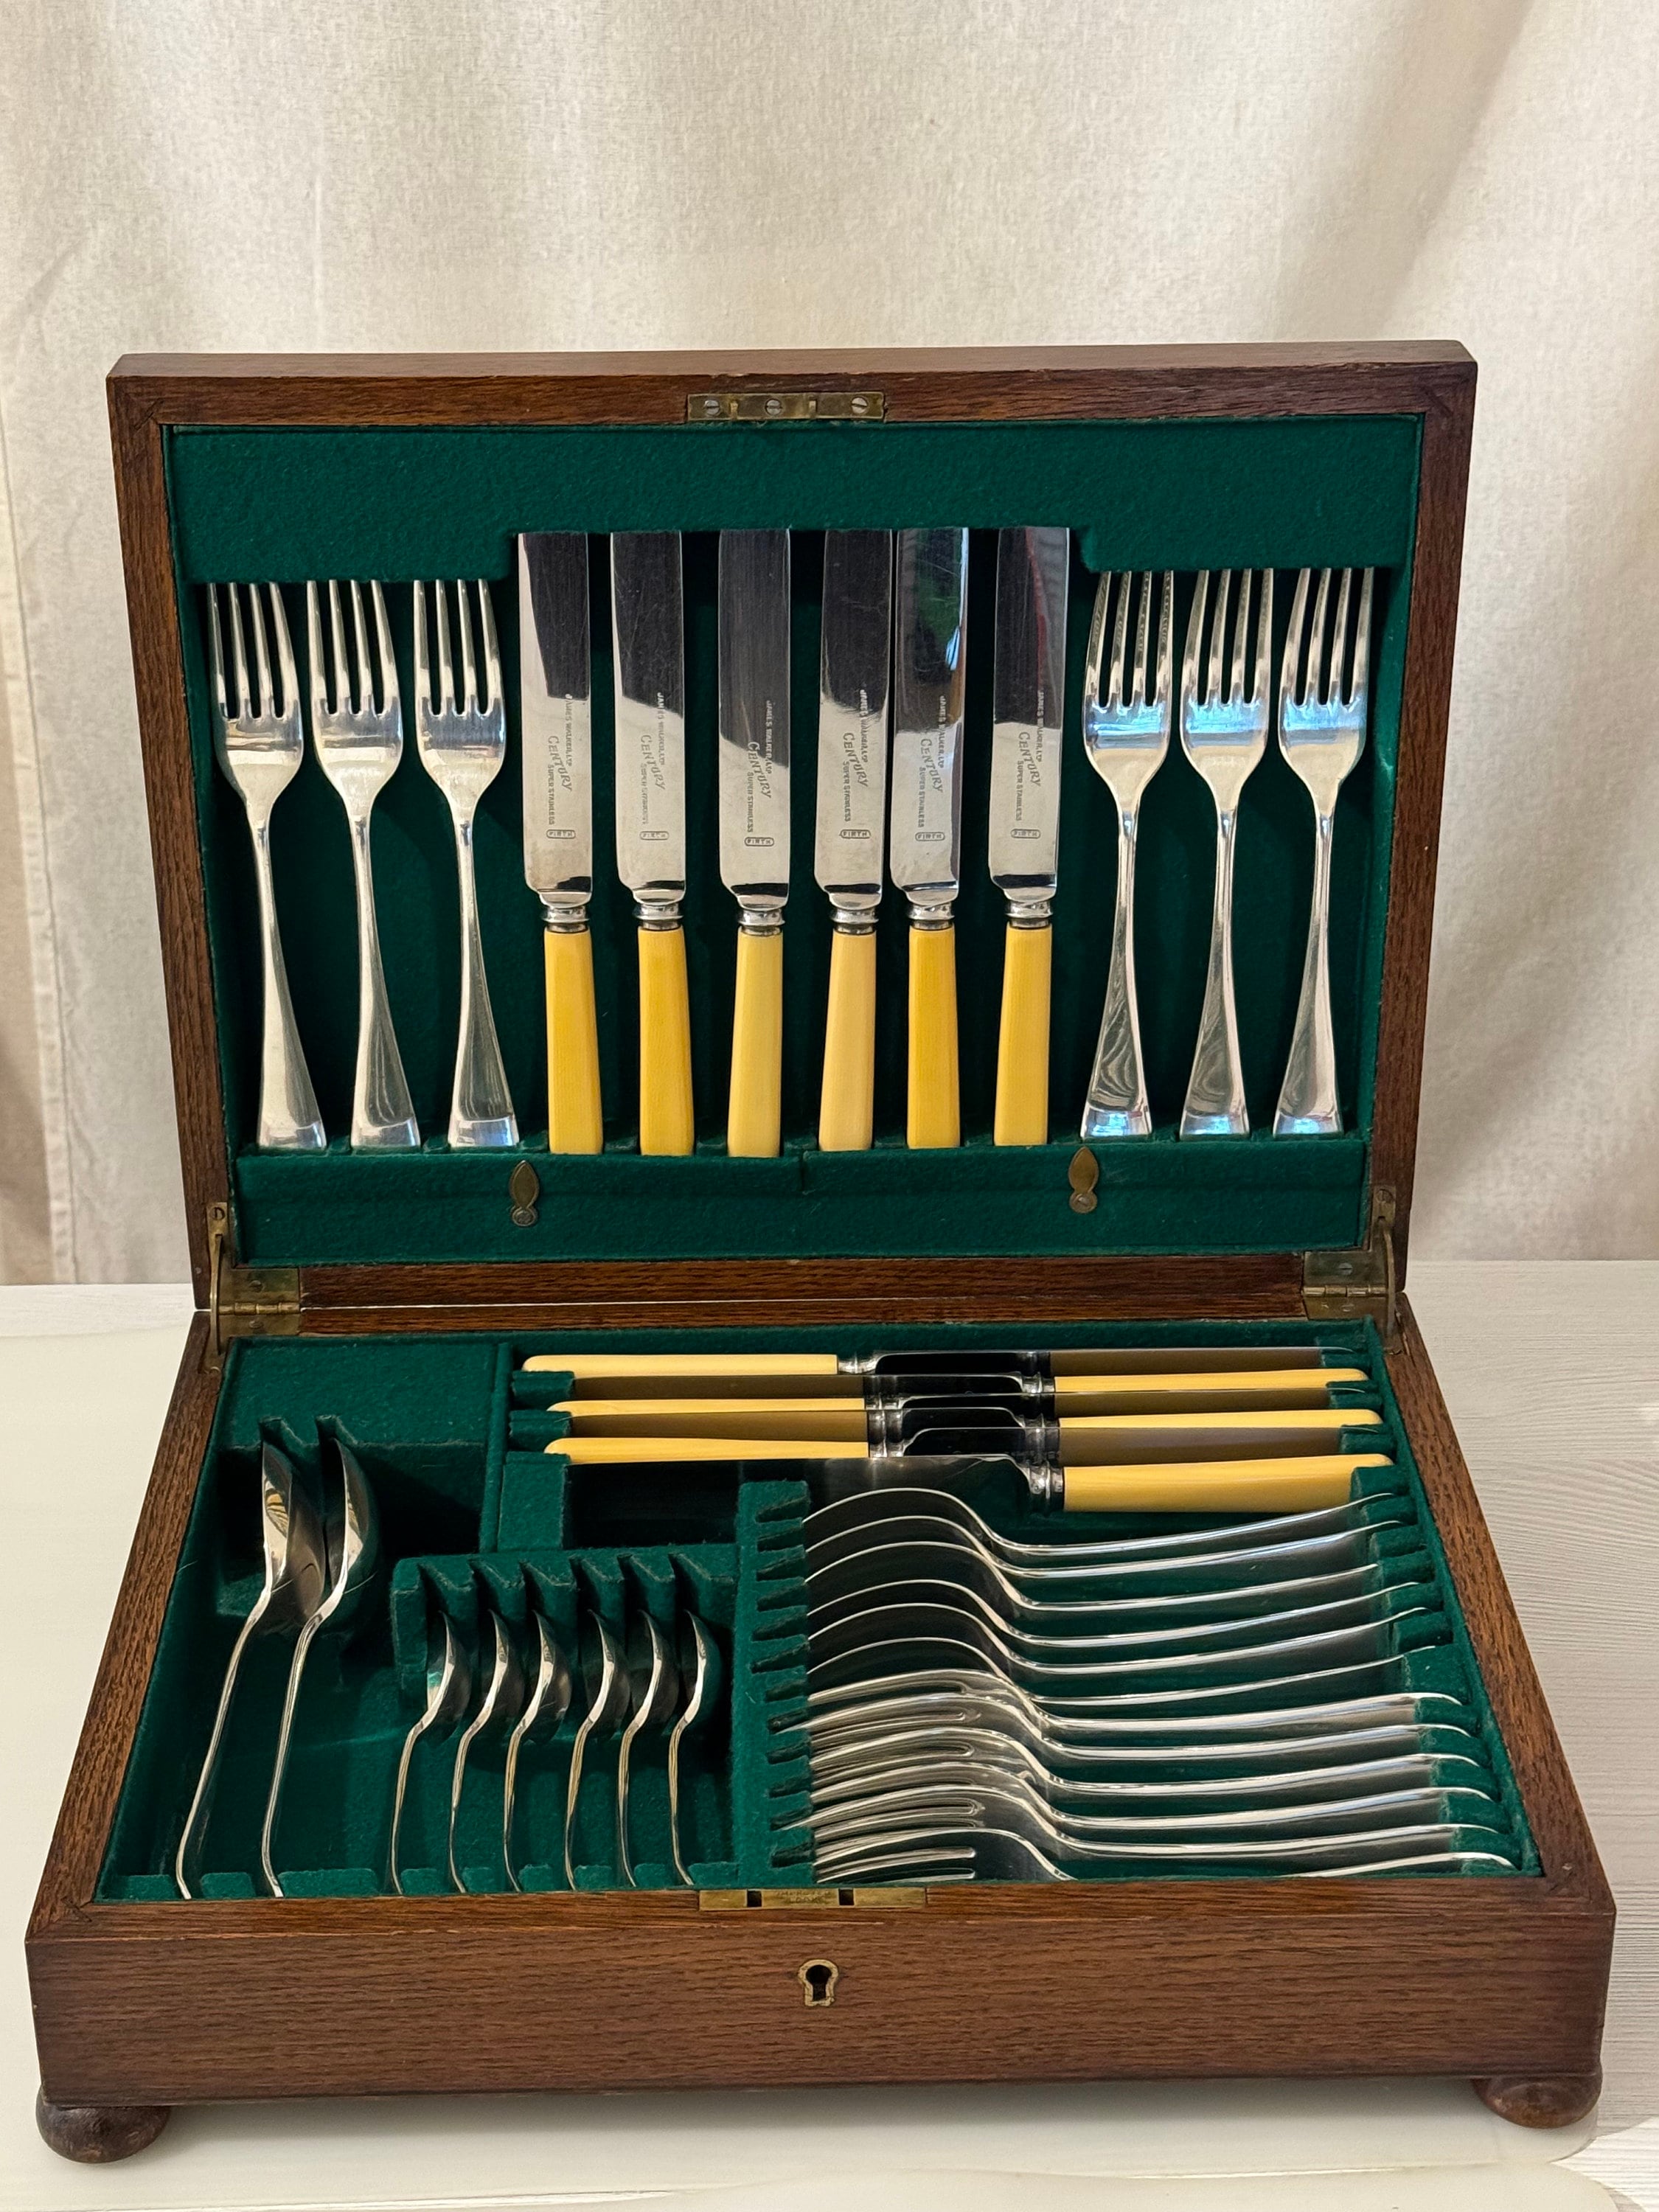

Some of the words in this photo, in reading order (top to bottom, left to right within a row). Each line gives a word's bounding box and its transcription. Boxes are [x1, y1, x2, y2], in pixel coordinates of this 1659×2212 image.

[548, 736, 573, 792] CENTURY
[641, 734, 666, 790] CENTURY
[748, 742, 772, 799] CENTURY
[843, 732, 869, 787] CENTURY
[920, 738, 944, 793] CENTURY
[1018, 731, 1042, 787] CENTURY
